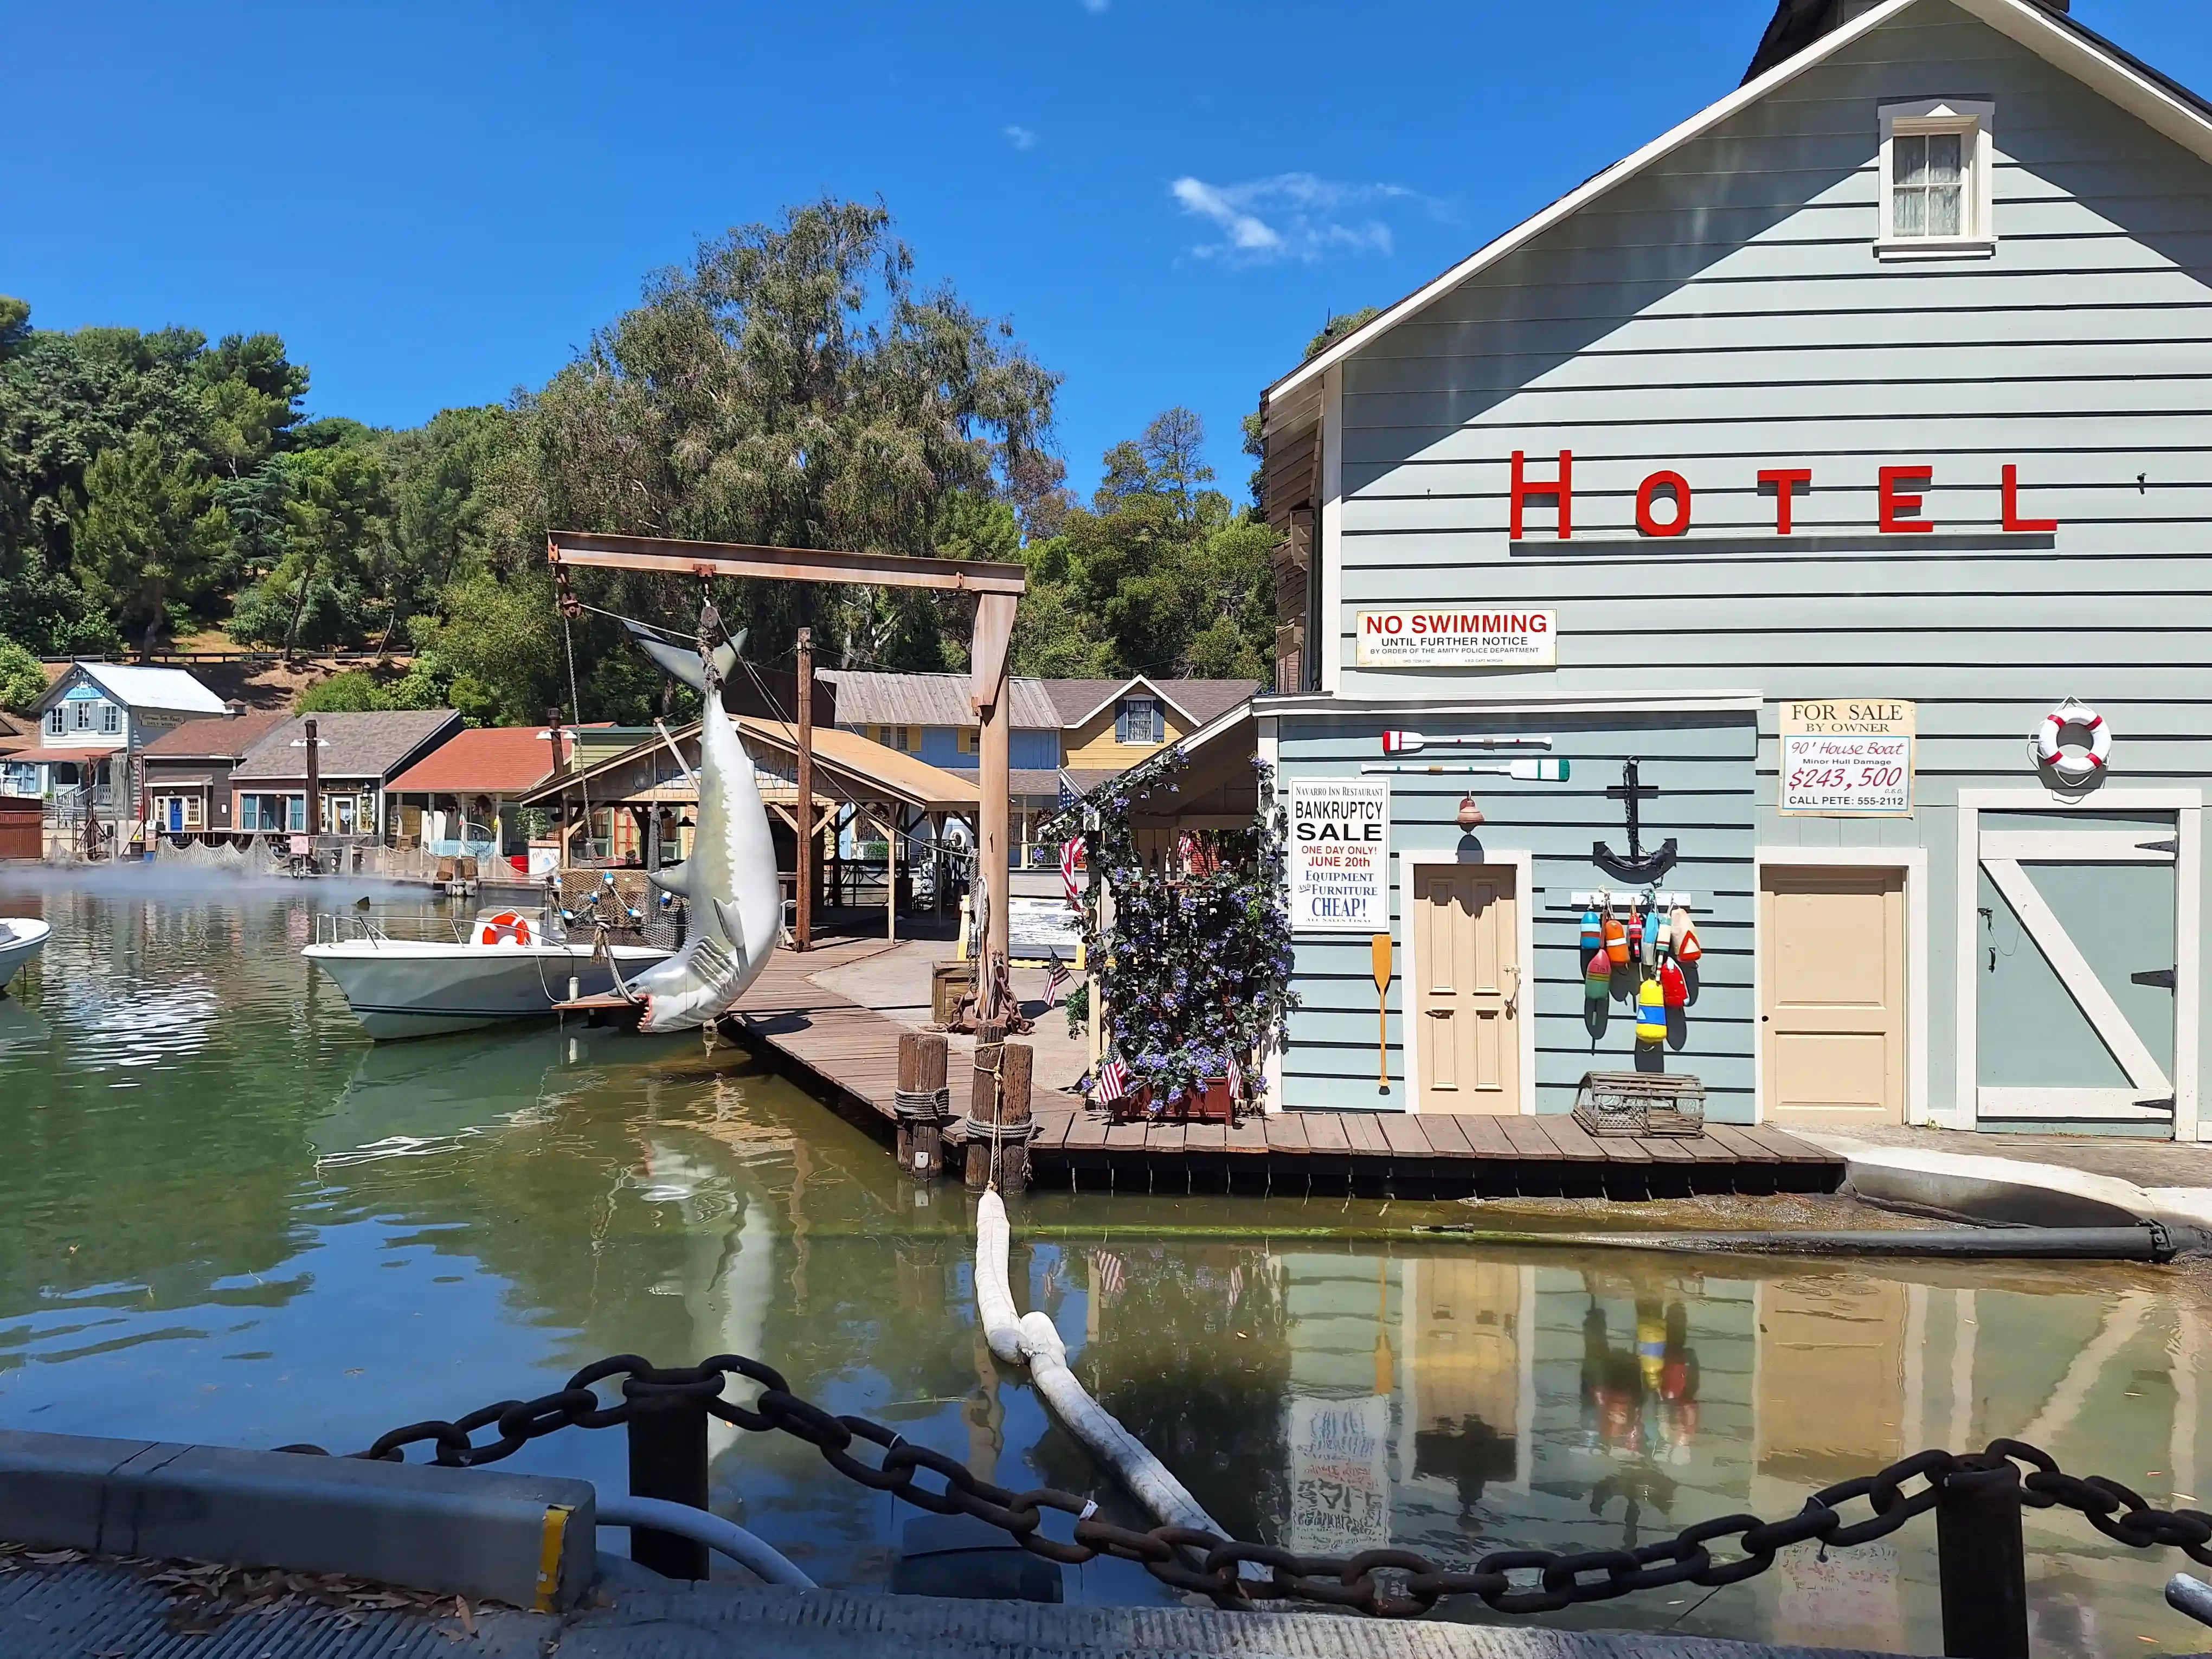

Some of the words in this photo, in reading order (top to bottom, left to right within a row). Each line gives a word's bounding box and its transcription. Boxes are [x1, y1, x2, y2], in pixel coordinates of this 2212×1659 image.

[1510, 450, 2058, 539] HOTEL
[1367, 615, 1403, 634] NO
[1412, 614, 1547, 634] SWIMMING
[1382, 638, 1416, 646] UNTIL
[1421, 637, 1478, 646] FURTHER
[1483, 636, 1528, 645] NOTICE
[1792, 704, 1838, 720] FOR
[1849, 704, 1903, 720] SALE
[1805, 723, 1825, 732] BY
[1831, 723, 1890, 732] OWNER
[1791, 742, 1816, 754] 90'
[1819, 742, 1864, 754] House
[1867, 742, 1904, 755] Boat
[1296, 787, 1327, 796] NAVARRO
[1329, 787, 1340, 796] INN
[1342, 787, 1383, 796] RESTAURANT
[1790, 796, 1818, 805] CALL
[1822, 796, 1854, 805] PETE:
[1857, 797, 1904, 805] 555-2112
[1296, 801, 1382, 819] BANKRUPTCY
[1296, 822, 1382, 841] SALE
[1302, 846, 1322, 854] ONE
[1326, 846, 1345, 854] DAY
[1348, 846, 1377, 854] ONLY!
[1308, 856, 1341, 866] JUNE
[1345, 857, 1370, 867] 20th
[1306, 870, 1374, 882] EQUIPMENT
[1312, 884, 1378, 895] FURNITURE
[1312, 897, 1366, 917] CHEAP!
